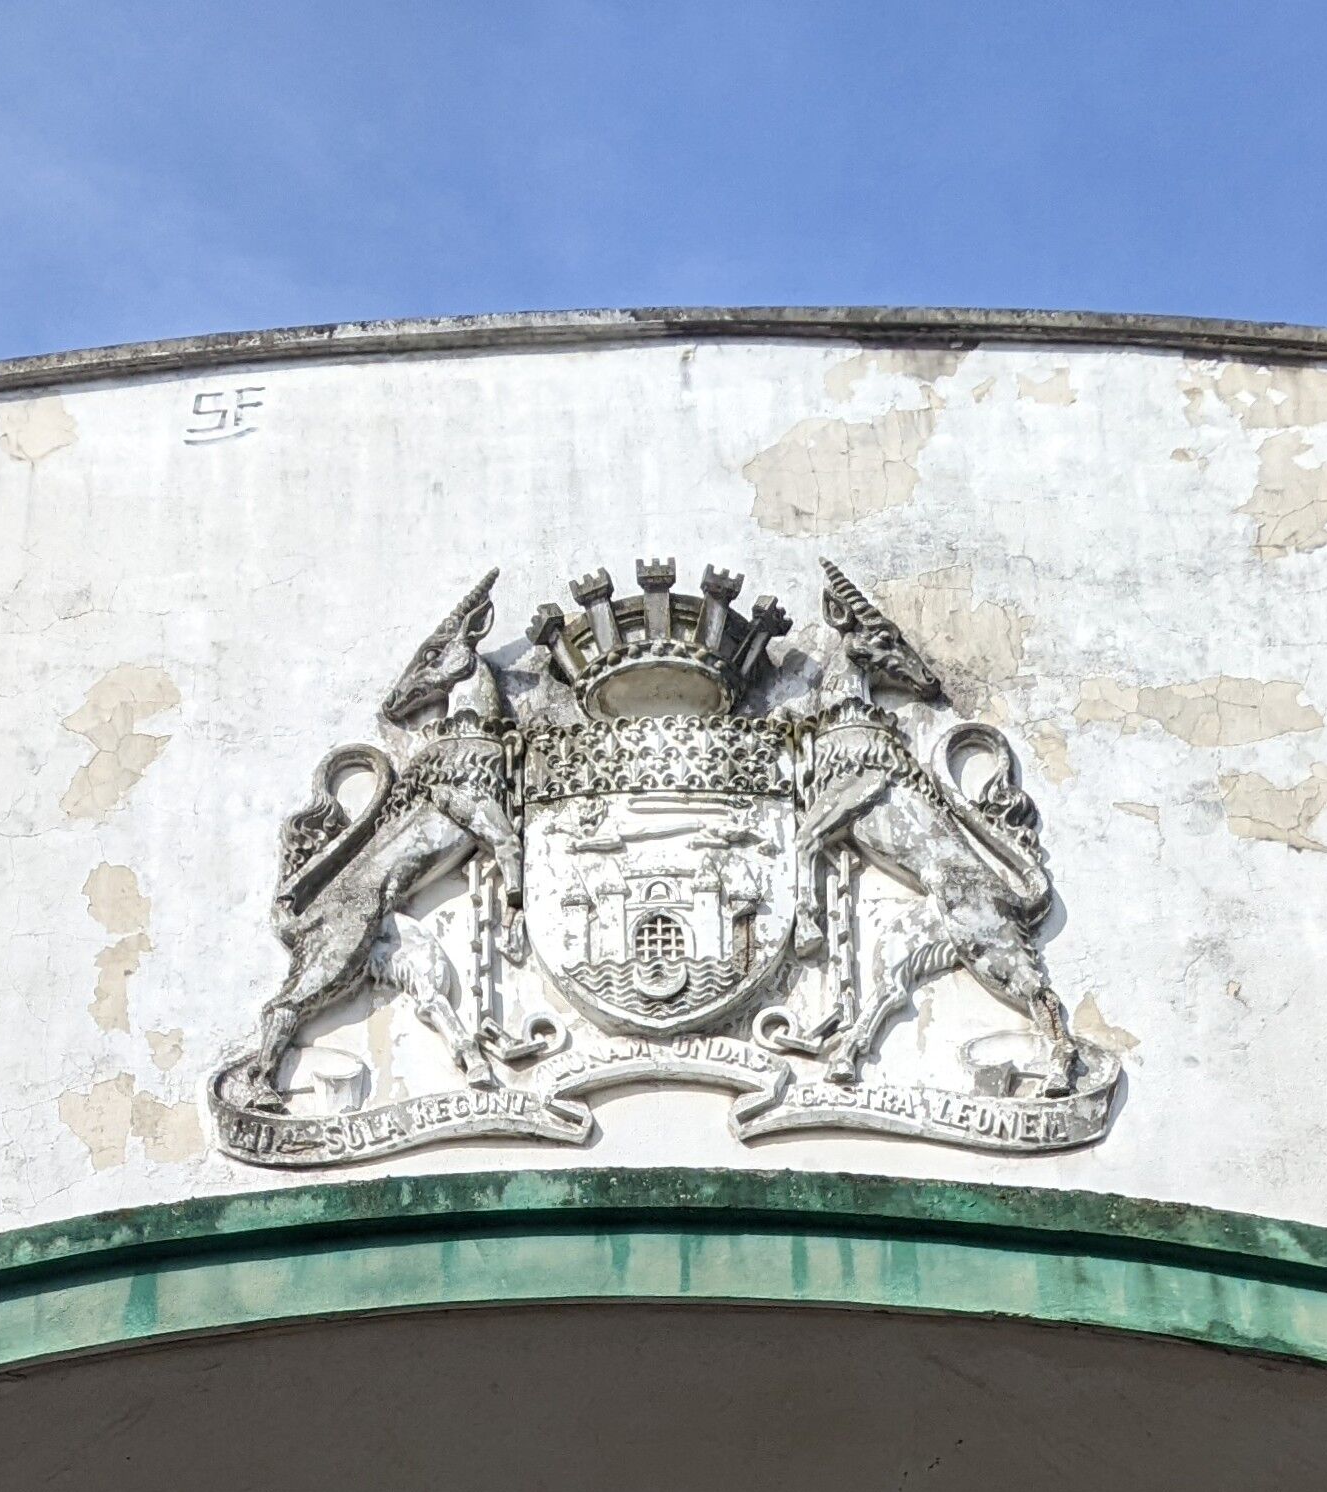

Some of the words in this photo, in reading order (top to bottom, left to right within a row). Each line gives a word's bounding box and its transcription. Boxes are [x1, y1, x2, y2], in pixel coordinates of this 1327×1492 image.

[673, 1036, 769, 1072] UNDAS
[795, 1084, 915, 1119] CASTRA
[930, 1092, 1069, 1142] LEONEM
